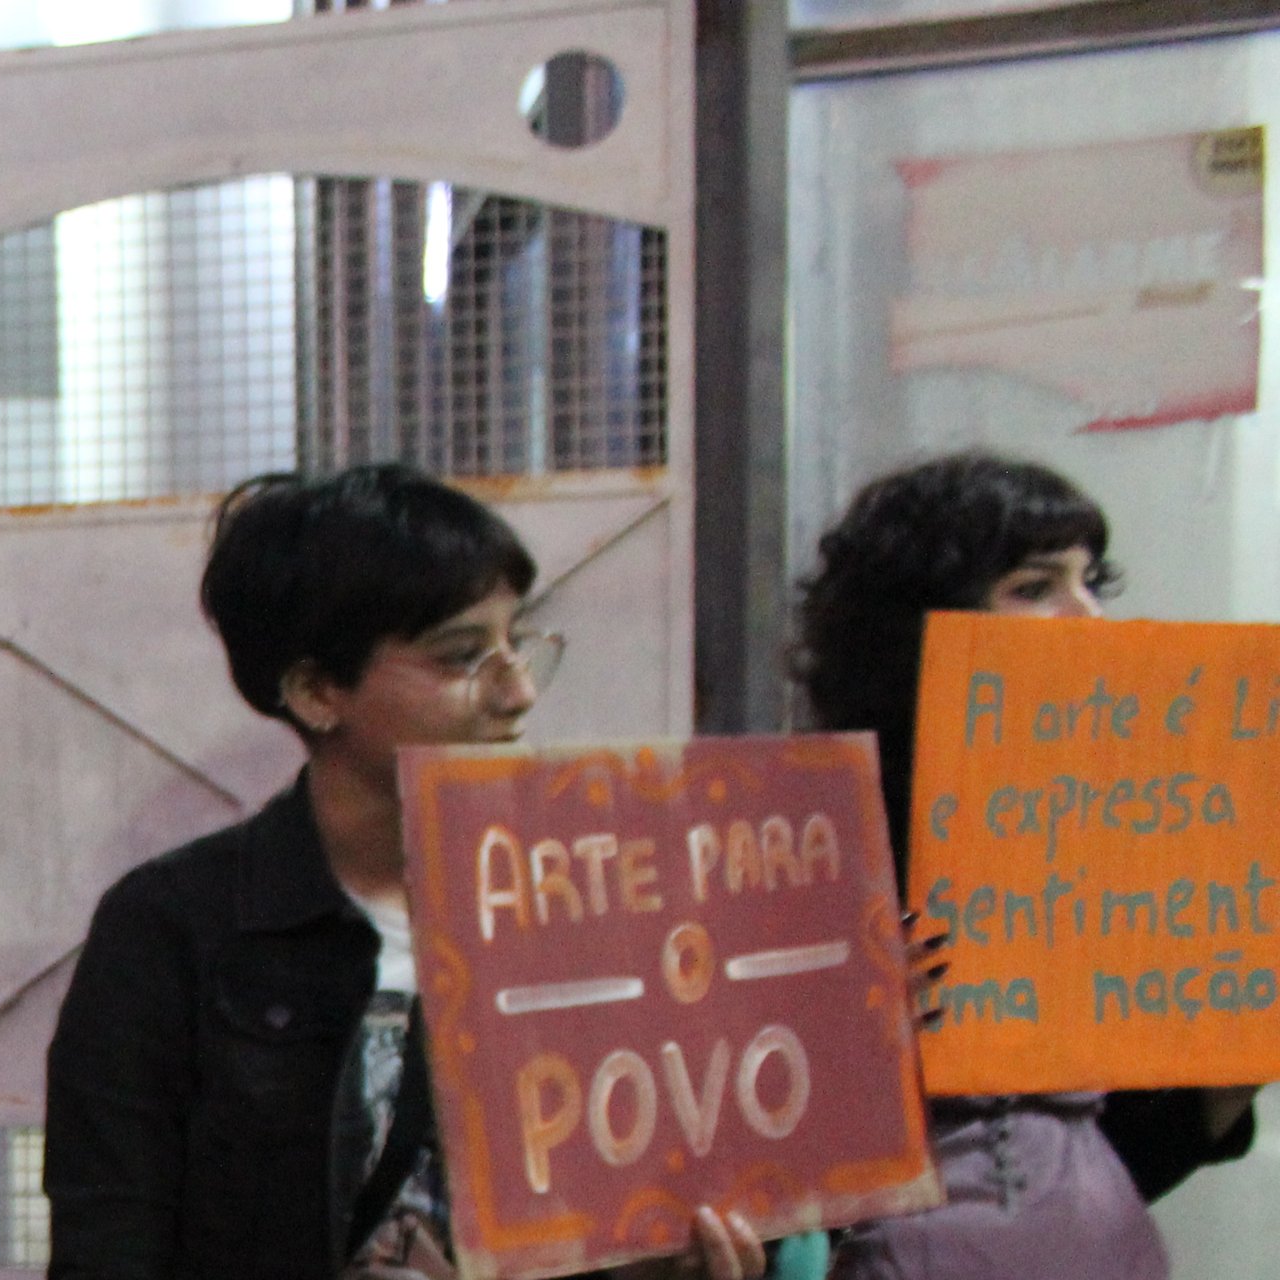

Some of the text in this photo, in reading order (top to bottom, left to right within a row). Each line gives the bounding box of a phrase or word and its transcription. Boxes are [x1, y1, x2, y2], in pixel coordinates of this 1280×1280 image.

[965, 671, 1005, 747] A
[1032, 678, 1139, 741] arte
[1163, 664, 1204, 737] é
[930, 773, 1236, 863] e expressa
[476, 813, 840, 942] ARTE PARA
[661, 921, 714, 1004] O
[1093, 949, 1278, 1023] nação
[515, 1024, 811, 1194] POVO
